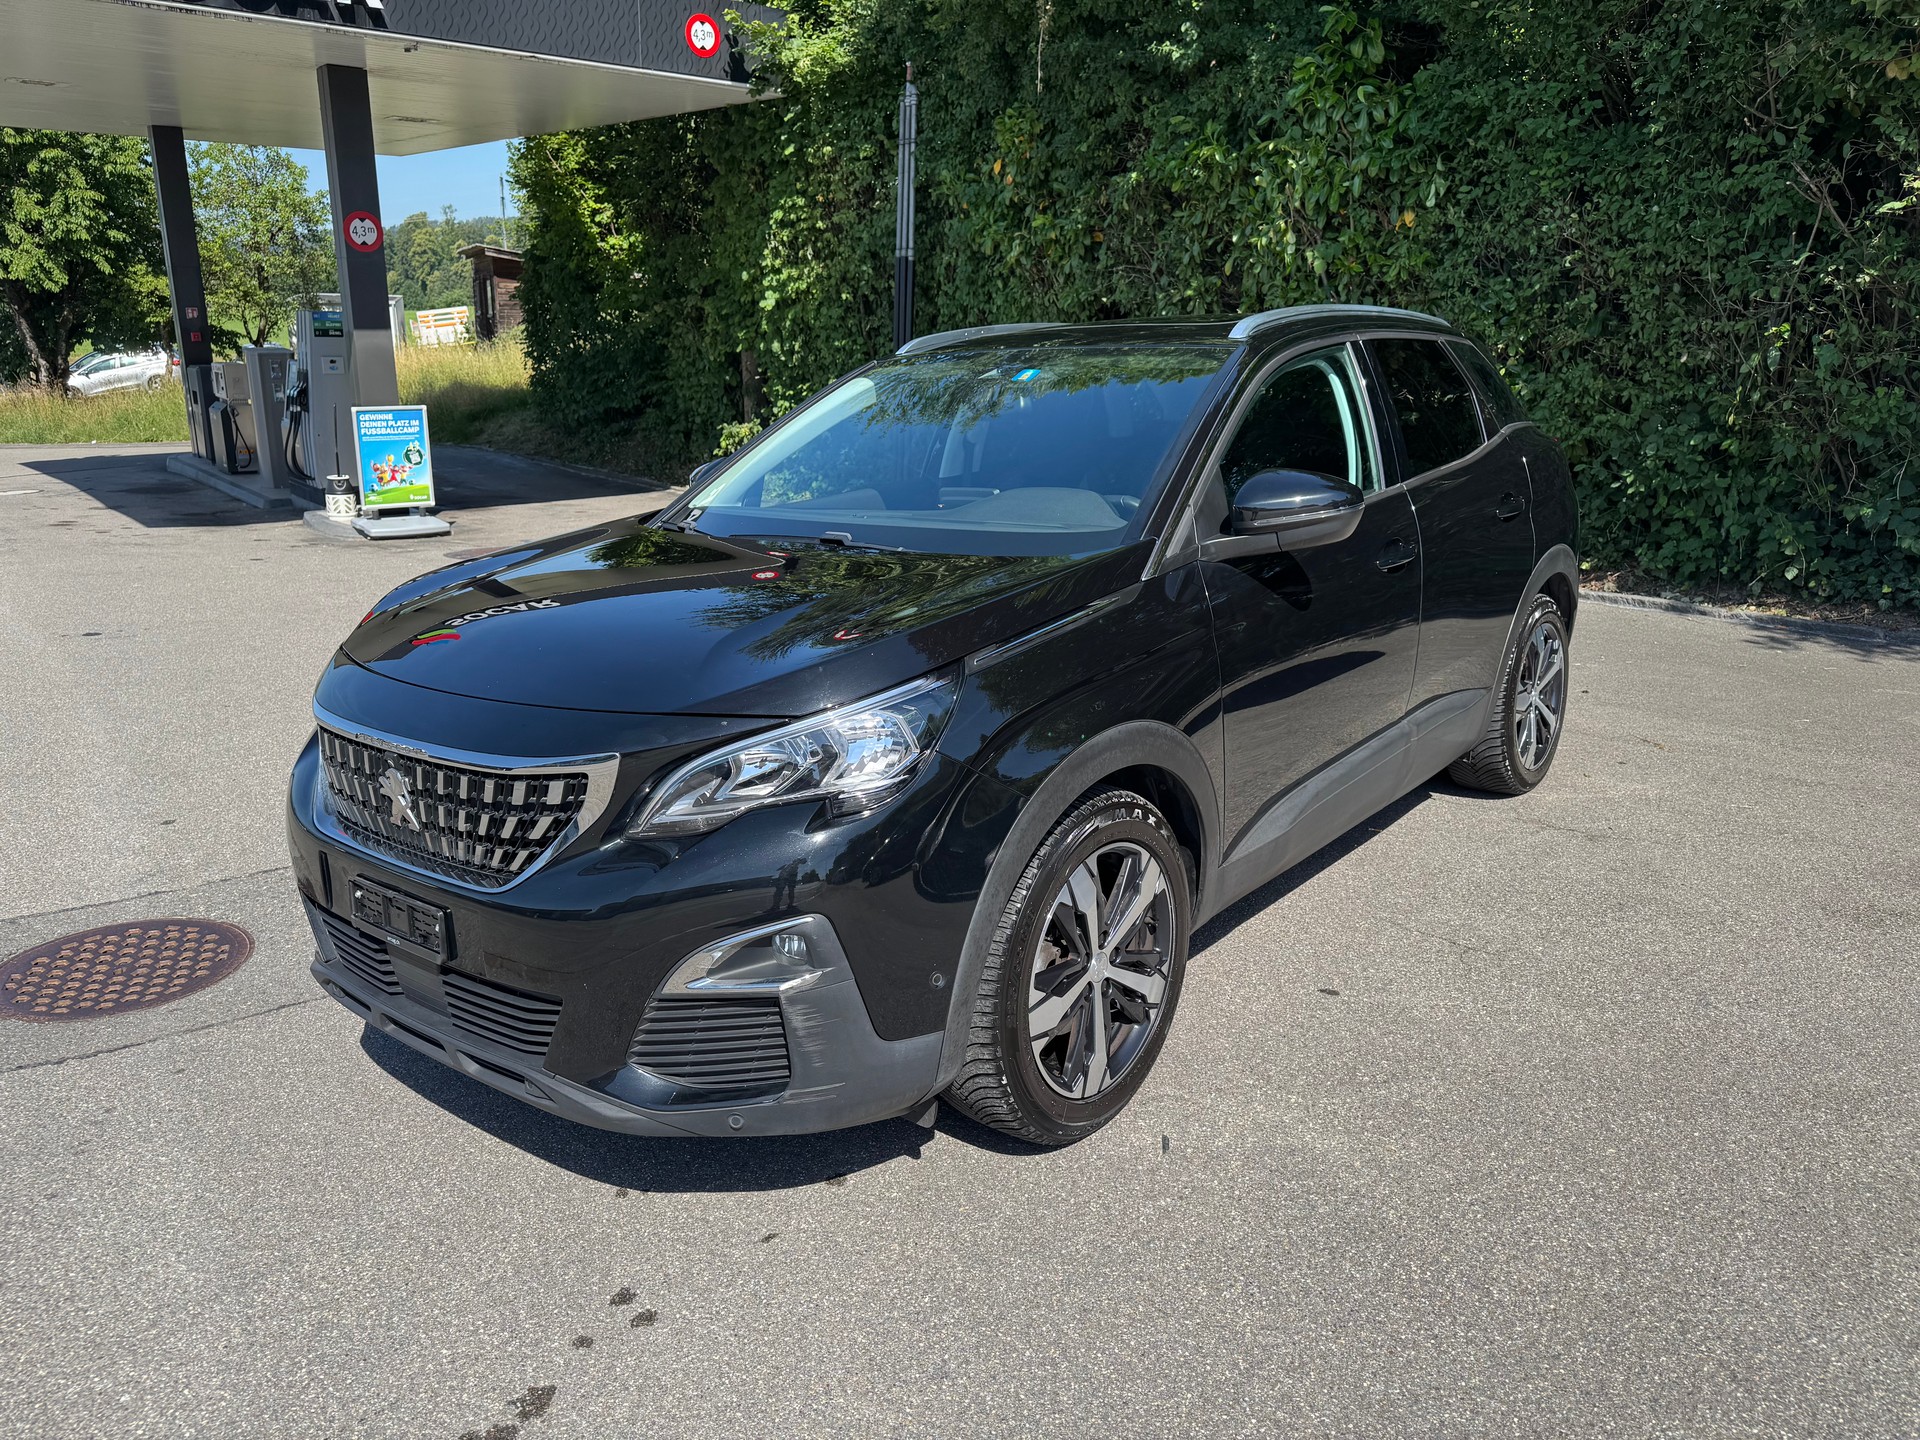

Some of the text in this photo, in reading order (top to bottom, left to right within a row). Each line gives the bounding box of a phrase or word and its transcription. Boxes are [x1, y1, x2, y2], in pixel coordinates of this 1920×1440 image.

[359, 413, 393, 421] GEWINNE
[360, 420, 387, 428] DEINEN
[361, 426, 420, 435] FUSSBALLCAMP
